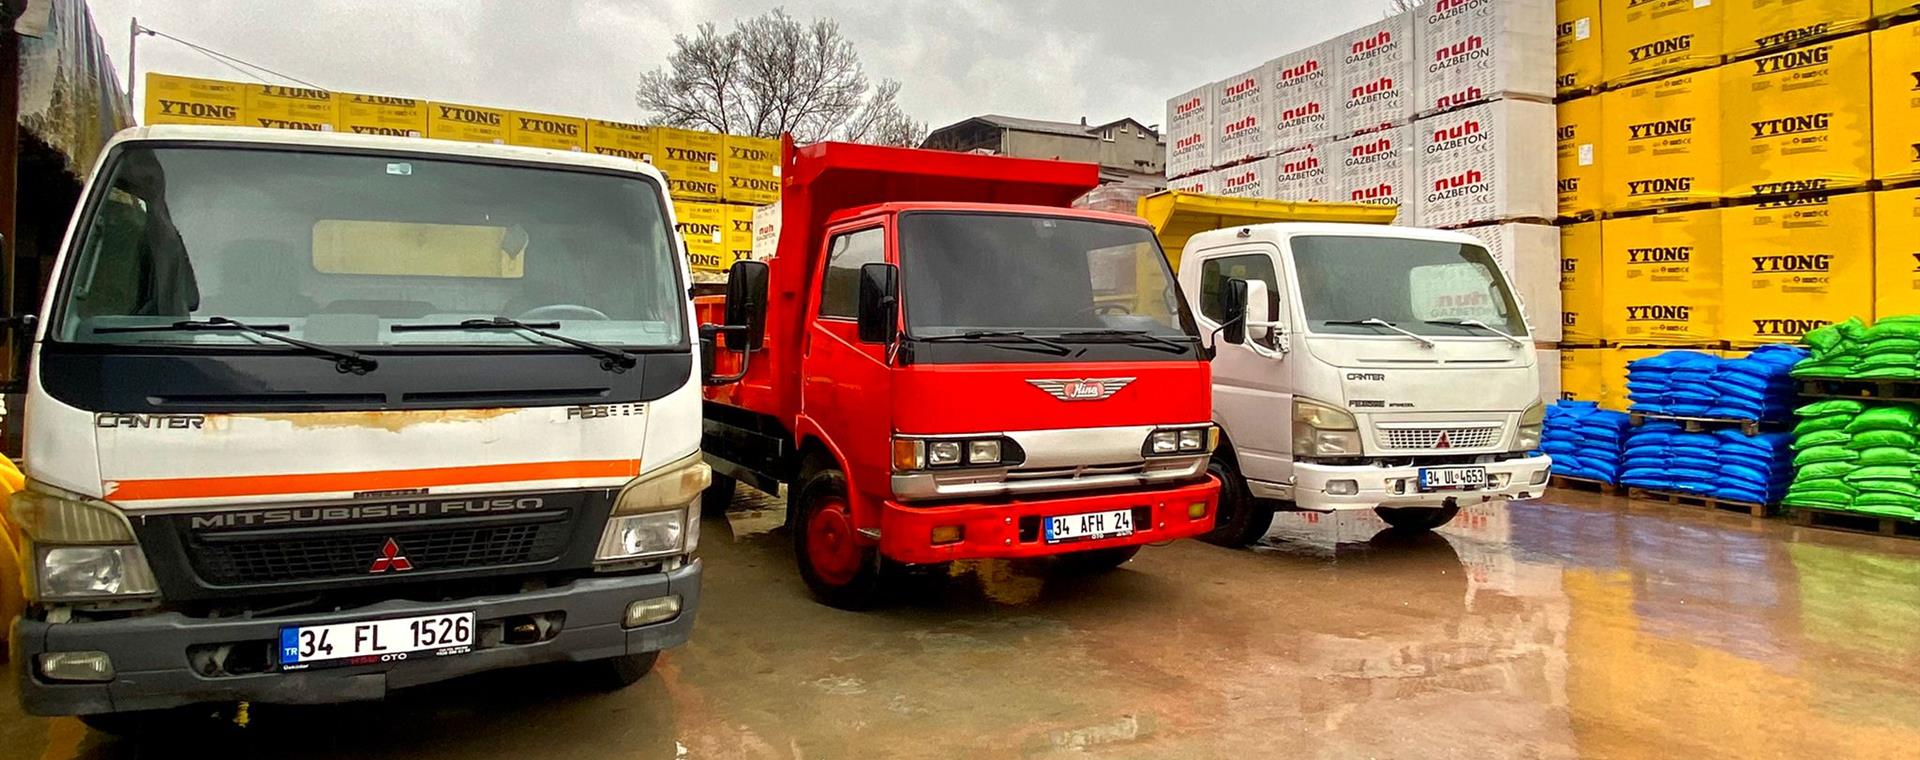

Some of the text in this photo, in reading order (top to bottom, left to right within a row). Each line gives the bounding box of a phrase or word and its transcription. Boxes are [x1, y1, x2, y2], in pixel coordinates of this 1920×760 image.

[1352, 31, 1390, 54] nuh
[1436, 35, 1482, 61] nuh
[1629, 35, 1691, 62] YTONG
[1345, 42, 1397, 64] GAZBETON
[1429, 47, 1489, 73] GAZBETON
[1754, 46, 1828, 74] YTONG
[1282, 60, 1318, 80] nuh
[1226, 78, 1255, 96] nuh
[1276, 70, 1324, 90] GAZBETON
[1352, 77, 1392, 98] nuh
[1177, 97, 1200, 114] nuh
[1221, 87, 1260, 105] GAZBETON
[1345, 89, 1398, 109] GAZBETON
[1437, 86, 1481, 108] nuh
[158, 99, 236, 119] YTONG
[440, 105, 500, 125] YTONG
[1283, 101, 1319, 121] nuh
[519, 117, 578, 136] YTONG
[1226, 116, 1255, 134] nuh
[1277, 113, 1325, 130] GAZBETON
[1629, 118, 1691, 138] YTONG
[1751, 113, 1828, 136] YTONG
[1177, 133, 1201, 149] nuh
[1221, 127, 1260, 143] GAZBETON
[1434, 120, 1479, 143] nuh
[1352, 138, 1391, 157] nuh
[1427, 132, 1487, 154] GAZBETON
[665, 146, 717, 162] YTONG
[1345, 150, 1397, 166] GAZBETON
[1284, 157, 1318, 173] nuh
[729, 176, 779, 192] YTONG
[1227, 171, 1255, 187] nuh
[1278, 168, 1324, 182] GAZBETON
[1435, 169, 1481, 192] nuh
[1222, 181, 1260, 195] GAZBETON
[1352, 183, 1392, 200] nuh
[1428, 183, 1489, 203] GAZBETON
[1628, 177, 1690, 194] YTONG
[1627, 247, 1689, 262] YTONG
[1752, 255, 1829, 271] YTONG
[1626, 305, 1688, 320] YTONG
[1347, 373, 1384, 381] CANTER
[96, 414, 205, 429] CANTER
[1427, 469, 1483, 485] 34 UL 4653
[191, 497, 543, 529] MITSUBISHI FUSO
[1054, 518, 1069, 536] 34
[1081, 514, 1104, 533] AFH
[1114, 512, 1130, 530] 24
[284, 616, 470, 657] TR 34 FL 1526
[381, 653, 407, 662] OTO
